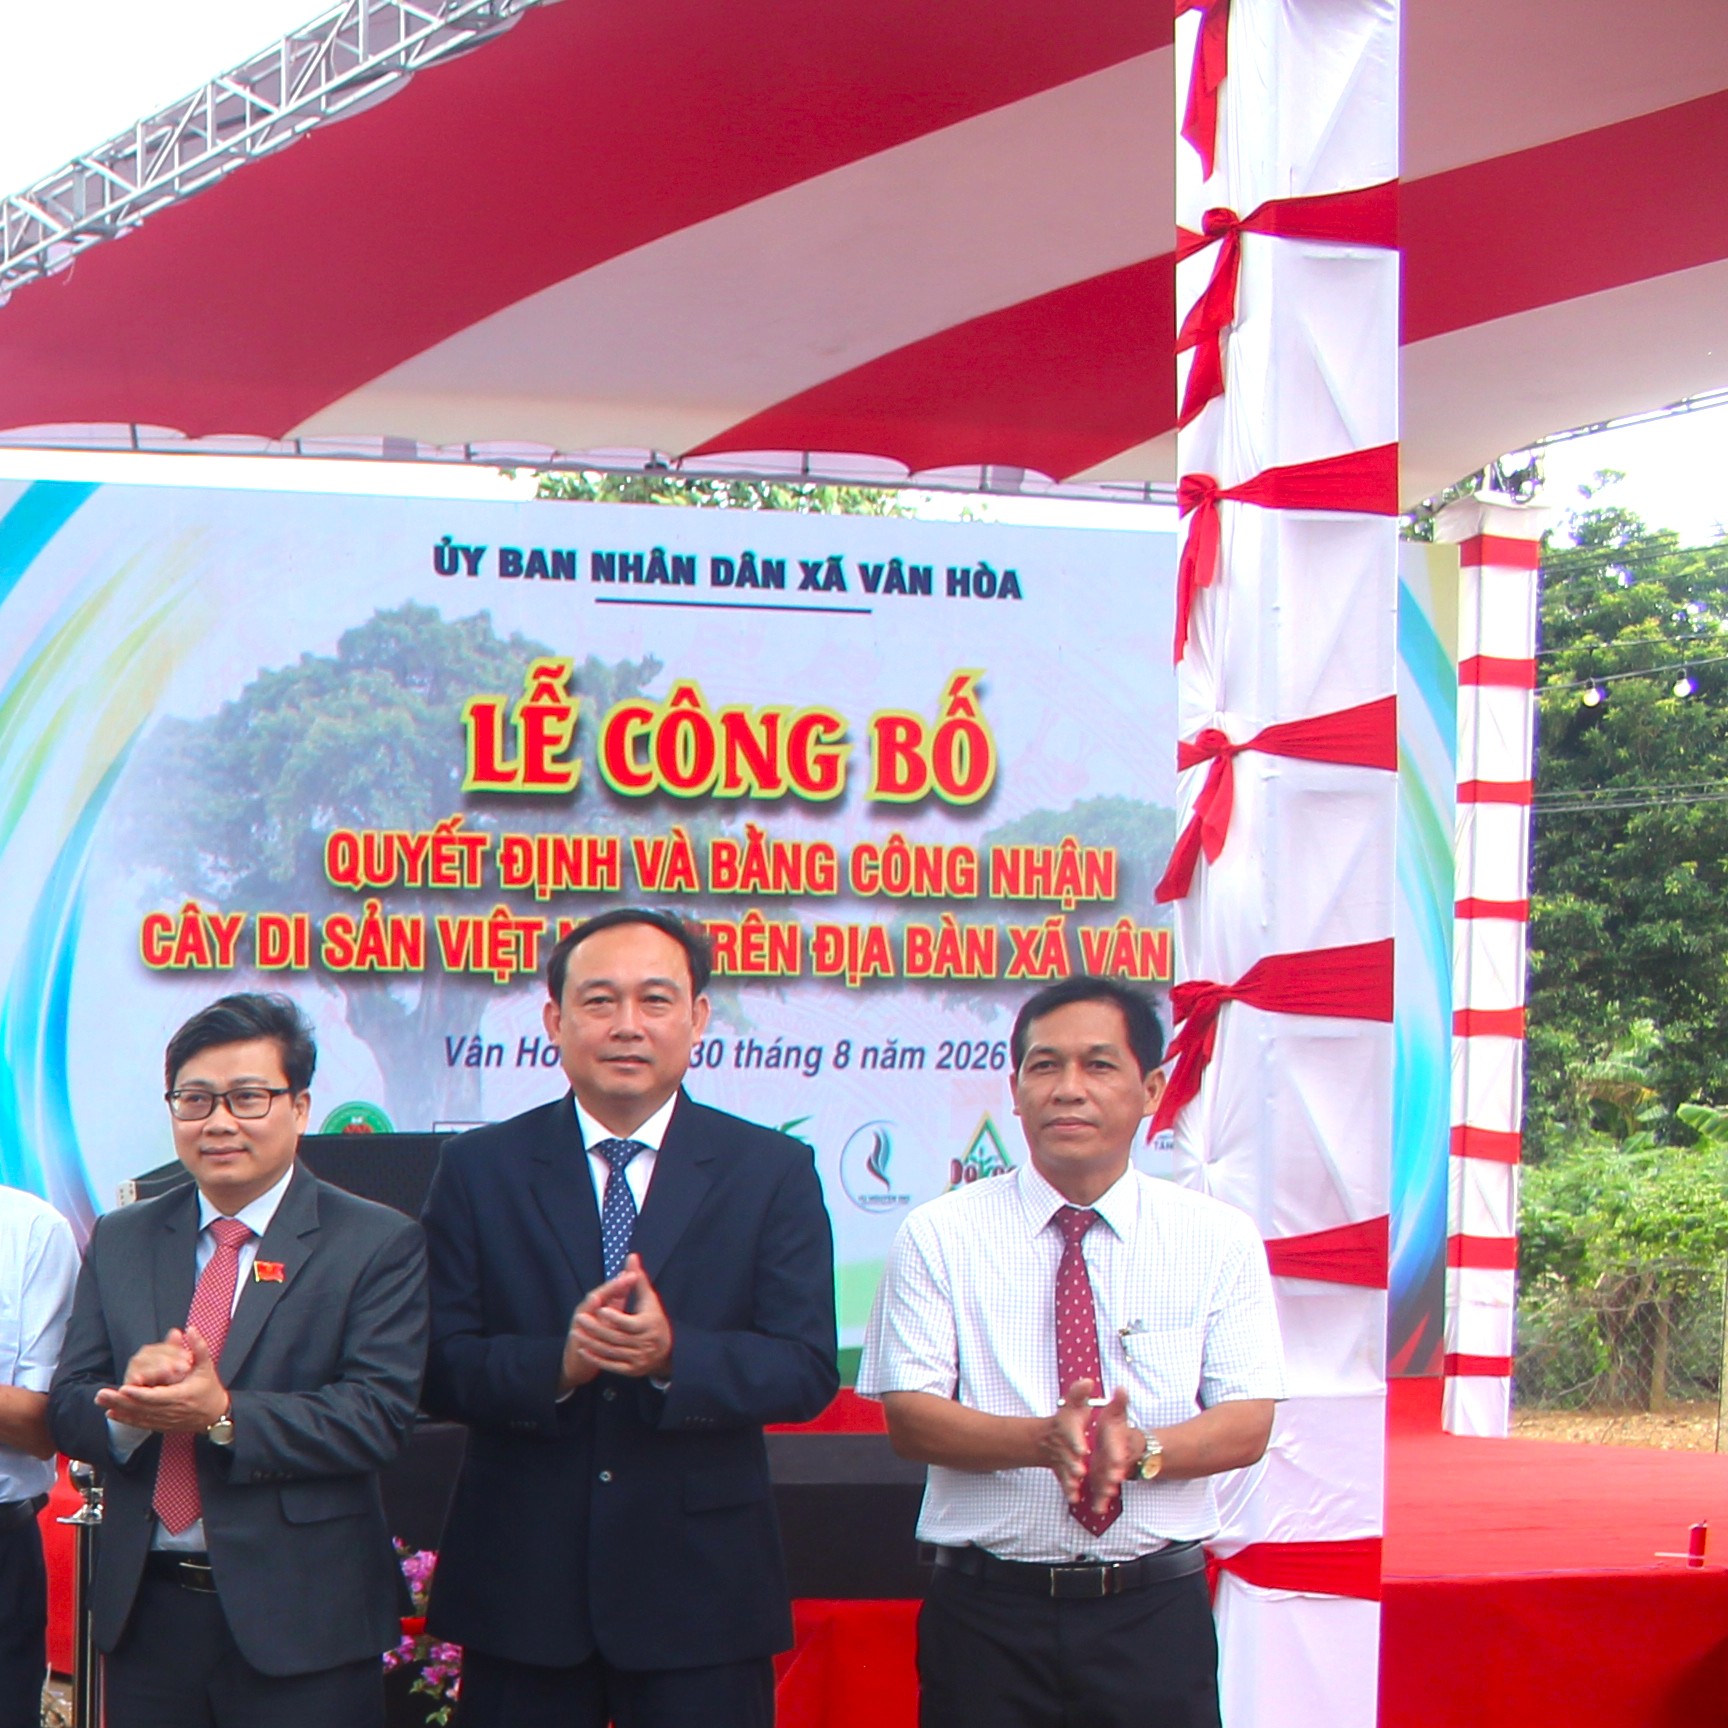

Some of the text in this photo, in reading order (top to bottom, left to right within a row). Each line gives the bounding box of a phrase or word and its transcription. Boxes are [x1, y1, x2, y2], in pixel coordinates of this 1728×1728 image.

[433, 536, 1023, 600] ỦY BAN NHÂN DÂN XÃ VÂN HÒA
[461, 656, 997, 804] LỄ CÔNG BỐ
[325, 813, 1117, 910] QUYẾT ĐỊNH VÀ BẰNG CÔNG NHẬN
[141, 898, 1171, 988] CÂY DI SẢN VIỆT RÊN ĐỊA BÀN XÃ VÂN
[445, 1034, 504, 1067] Vân
[689, 1038, 724, 1069] 30
[734, 1036, 823, 1077] tháng
[832, 1039, 851, 1070] 8
[860, 1038, 926, 1069] năm
[935, 1040, 1007, 1070] 2026
